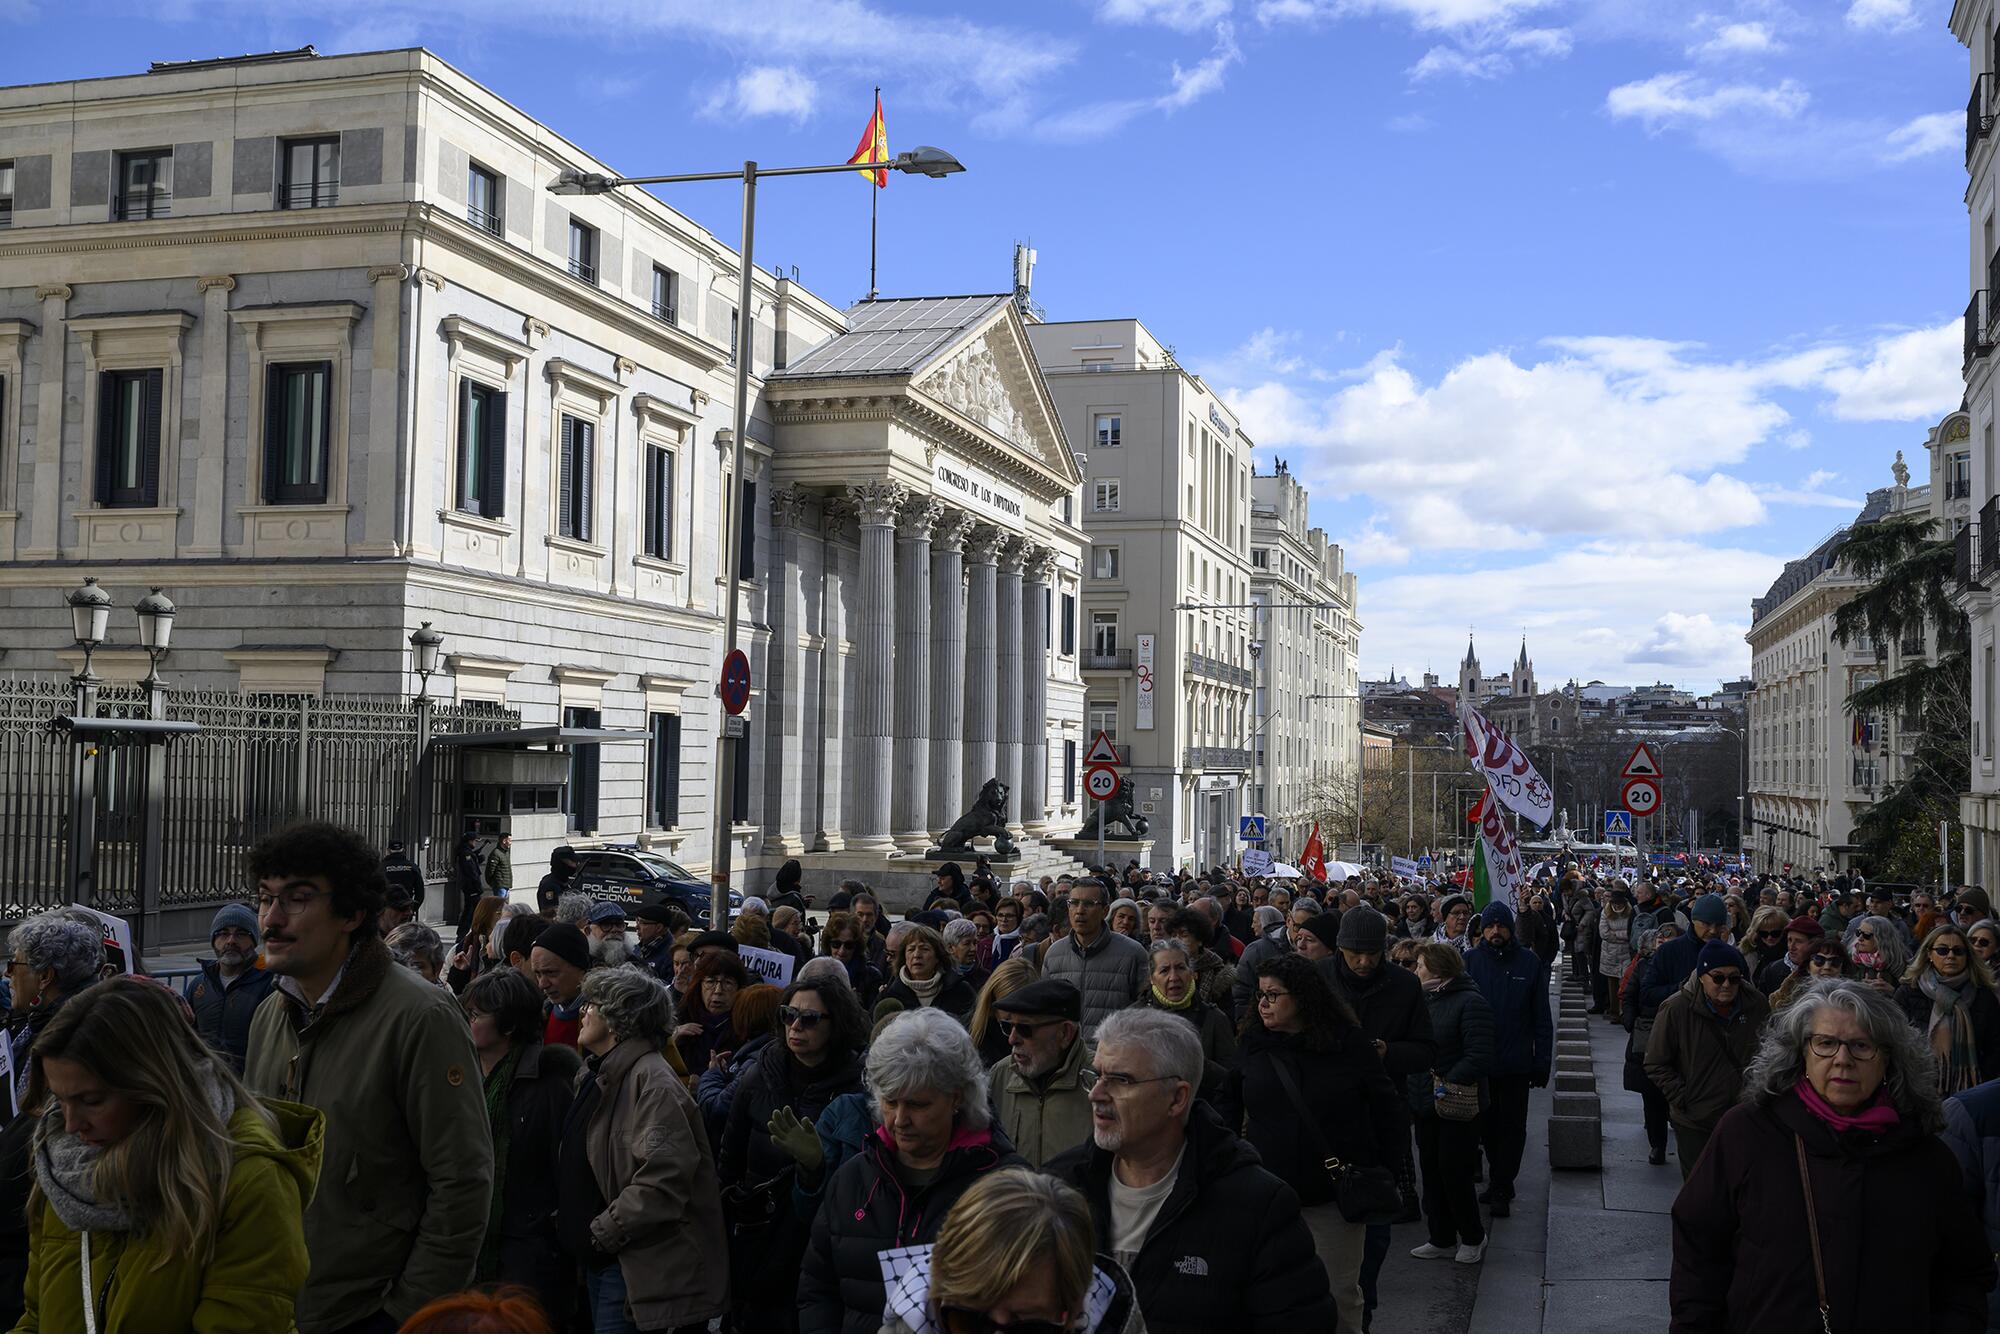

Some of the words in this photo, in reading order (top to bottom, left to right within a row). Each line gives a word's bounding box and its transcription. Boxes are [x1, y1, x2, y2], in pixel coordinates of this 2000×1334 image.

[938, 466, 969, 492] CONGRESO
[971, 482, 979, 498] DE
[981, 486, 992, 503] LOS
[994, 493, 1021, 517] DIPUTADOS
[1093, 777, 1111, 788] 20
[1631, 791, 1652, 803] 20
[582, 883, 630, 895] POLICIA
[582, 892, 642, 904] NACIONAL
[754, 957, 782, 980] CURA
